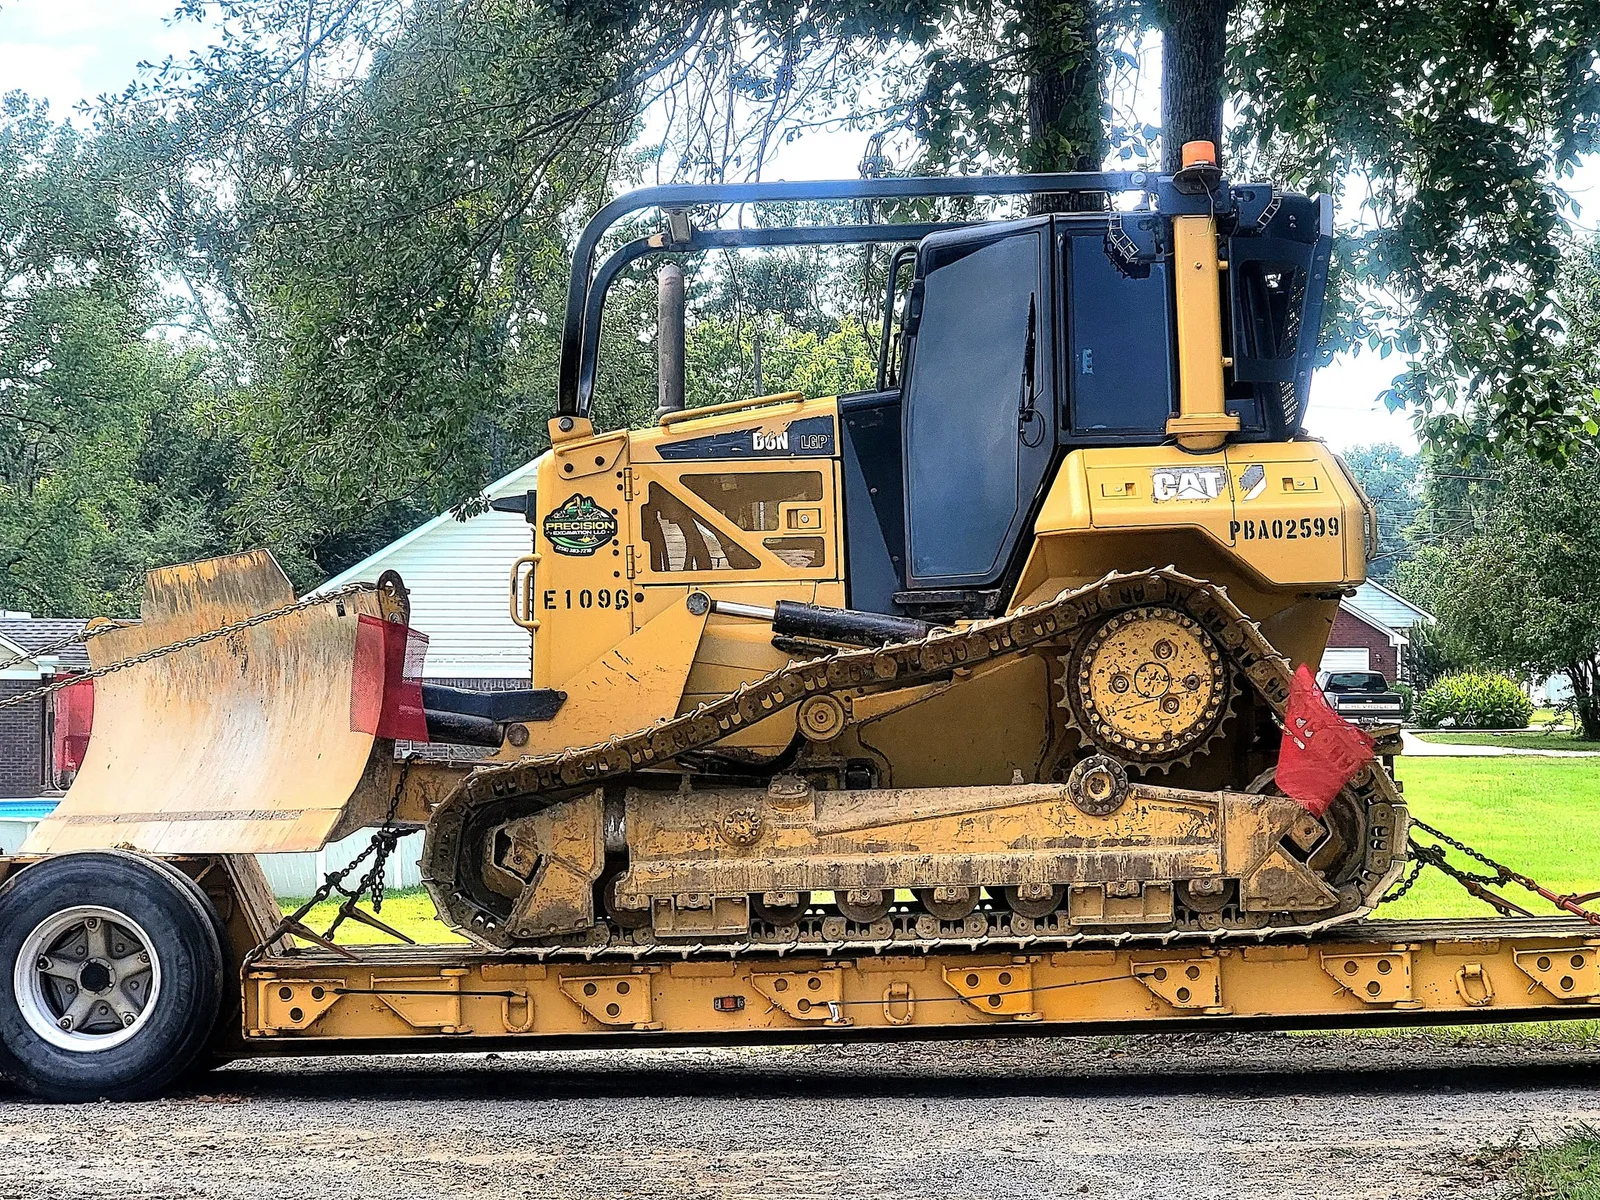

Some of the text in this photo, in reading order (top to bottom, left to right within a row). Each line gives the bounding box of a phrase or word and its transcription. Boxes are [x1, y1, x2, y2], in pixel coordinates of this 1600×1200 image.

[800, 434, 828, 449] LGP
[1152, 471, 1222, 501] CAT
[546, 521, 615, 530] PRECISION
[1229, 516, 1339, 541] PBA02599
